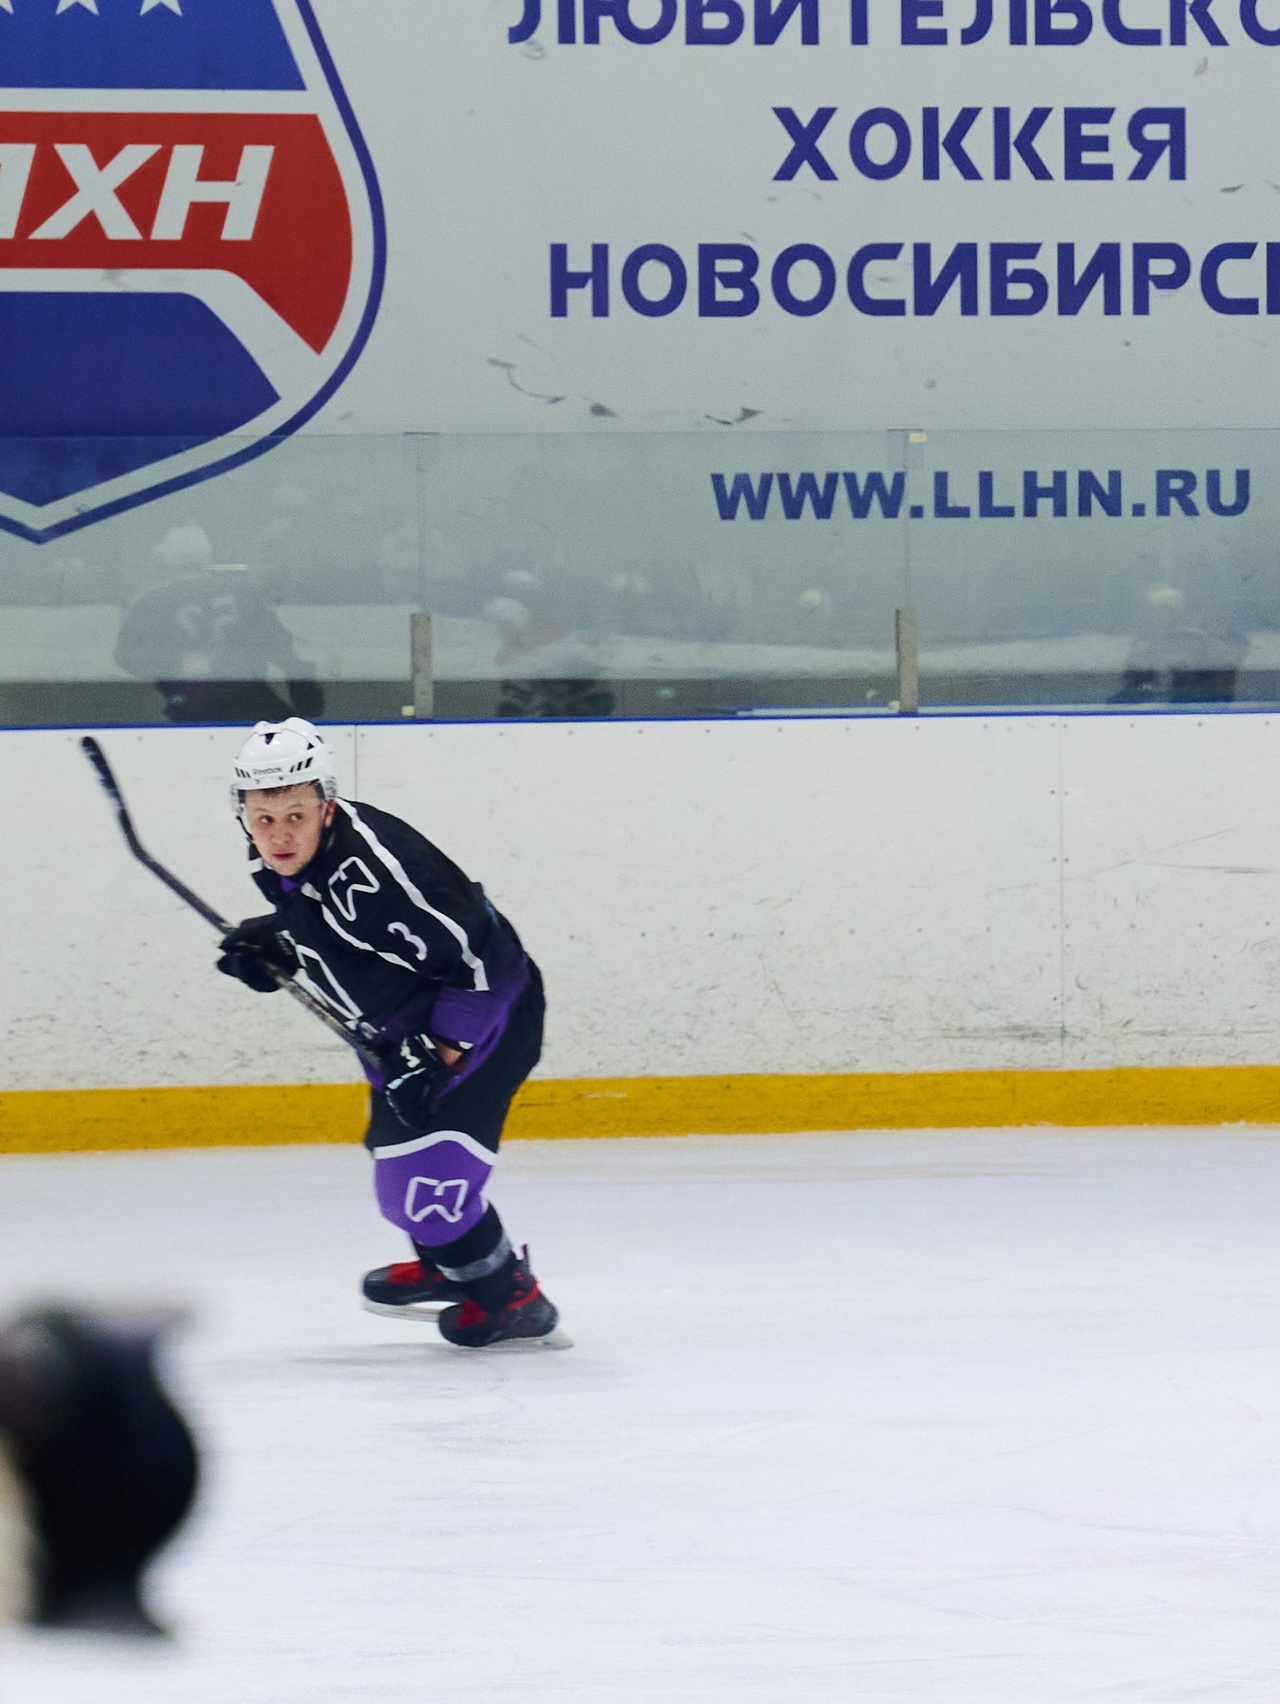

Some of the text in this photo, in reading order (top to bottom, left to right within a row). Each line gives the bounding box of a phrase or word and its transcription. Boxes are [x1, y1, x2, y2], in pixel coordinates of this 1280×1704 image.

[772, 107, 1187, 181] ХОККЕЯ
[711, 469, 1250, 520] WWW.LLHN.RU
[387, 921, 427, 961] 3
